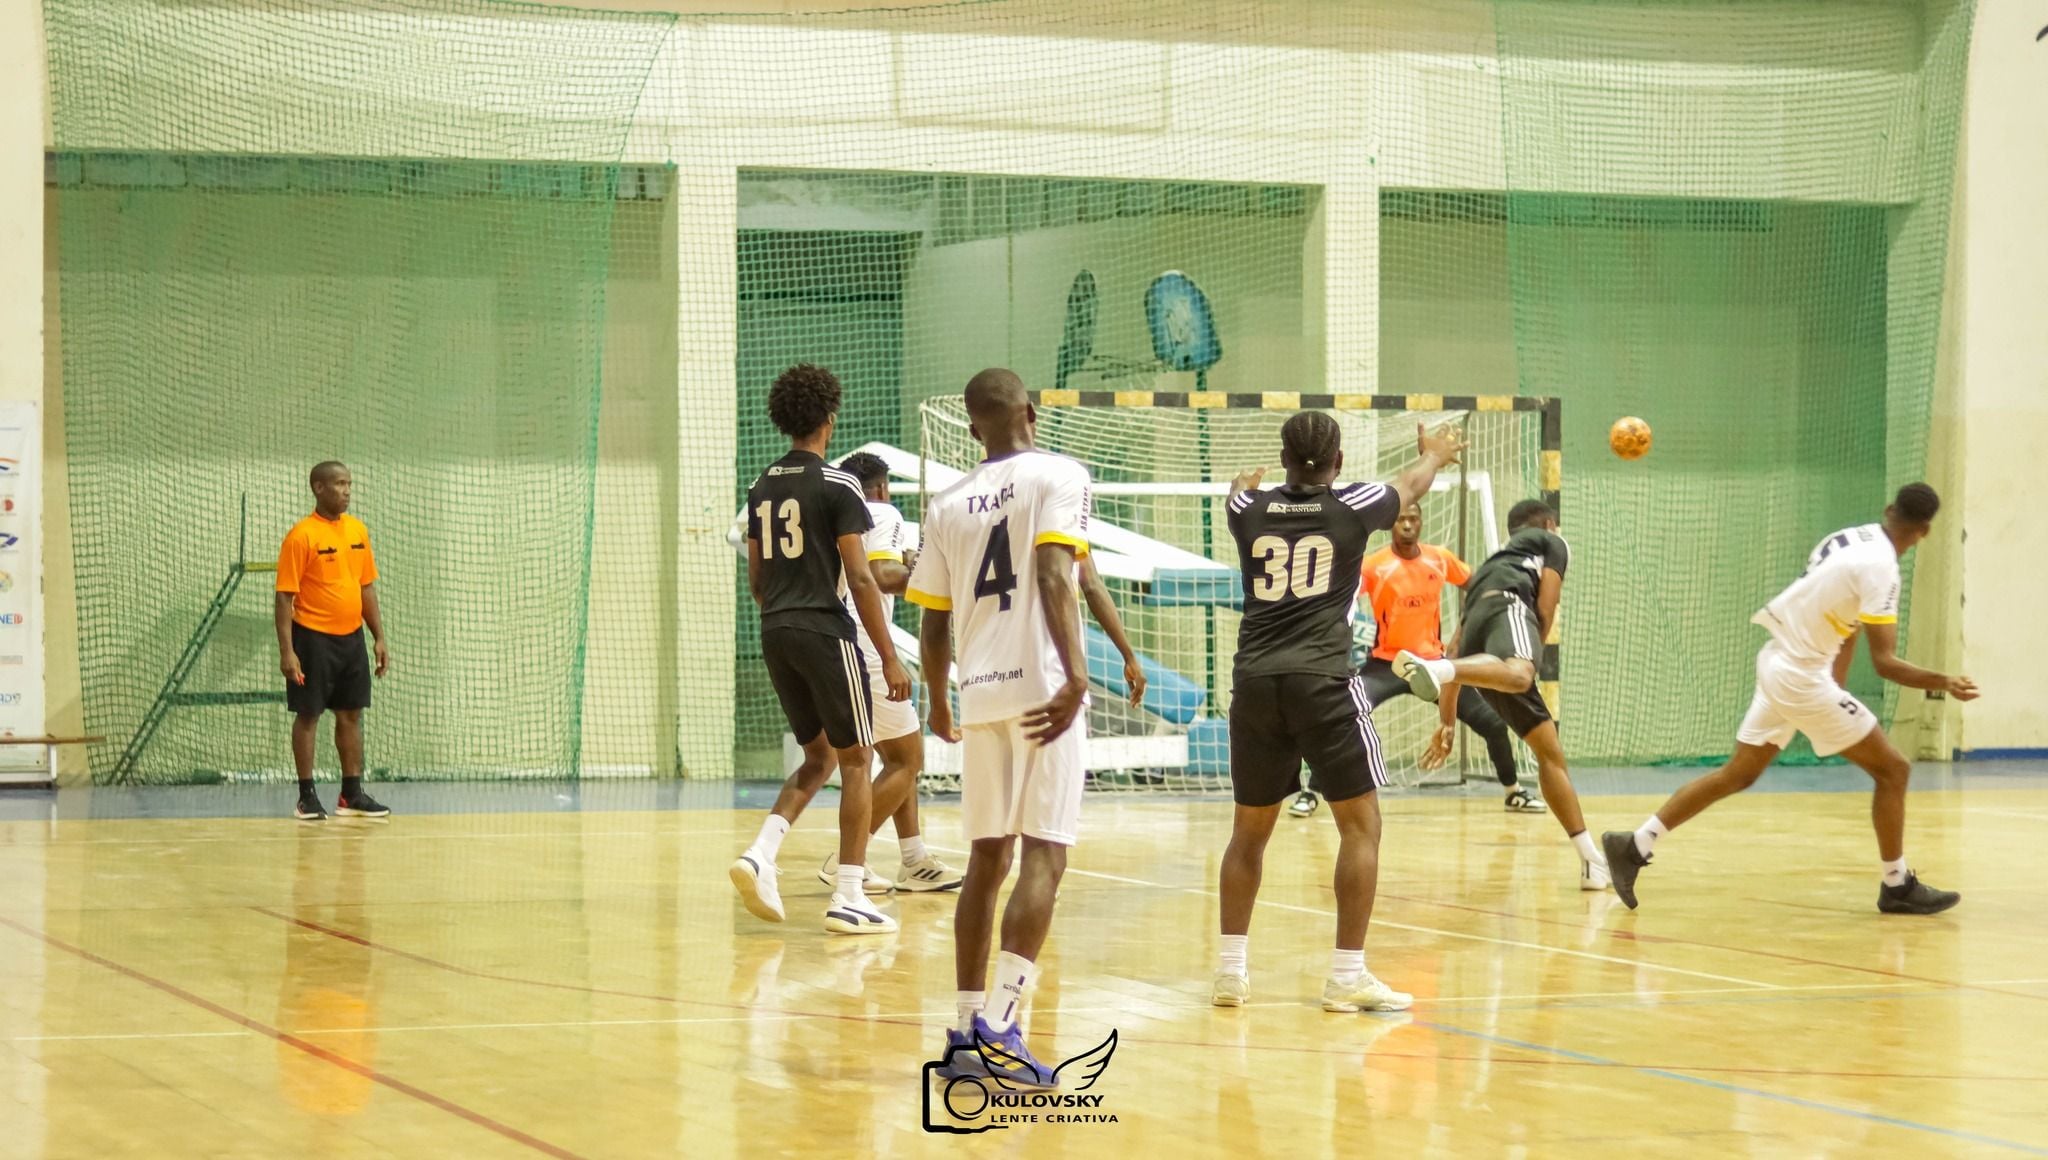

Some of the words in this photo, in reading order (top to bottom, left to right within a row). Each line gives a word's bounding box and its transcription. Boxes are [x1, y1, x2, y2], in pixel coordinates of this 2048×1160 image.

[755, 498, 804, 560] 13
[973, 514, 1018, 613] 4
[1252, 535, 1334, 601] 30
[1838, 700, 1858, 716] 5
